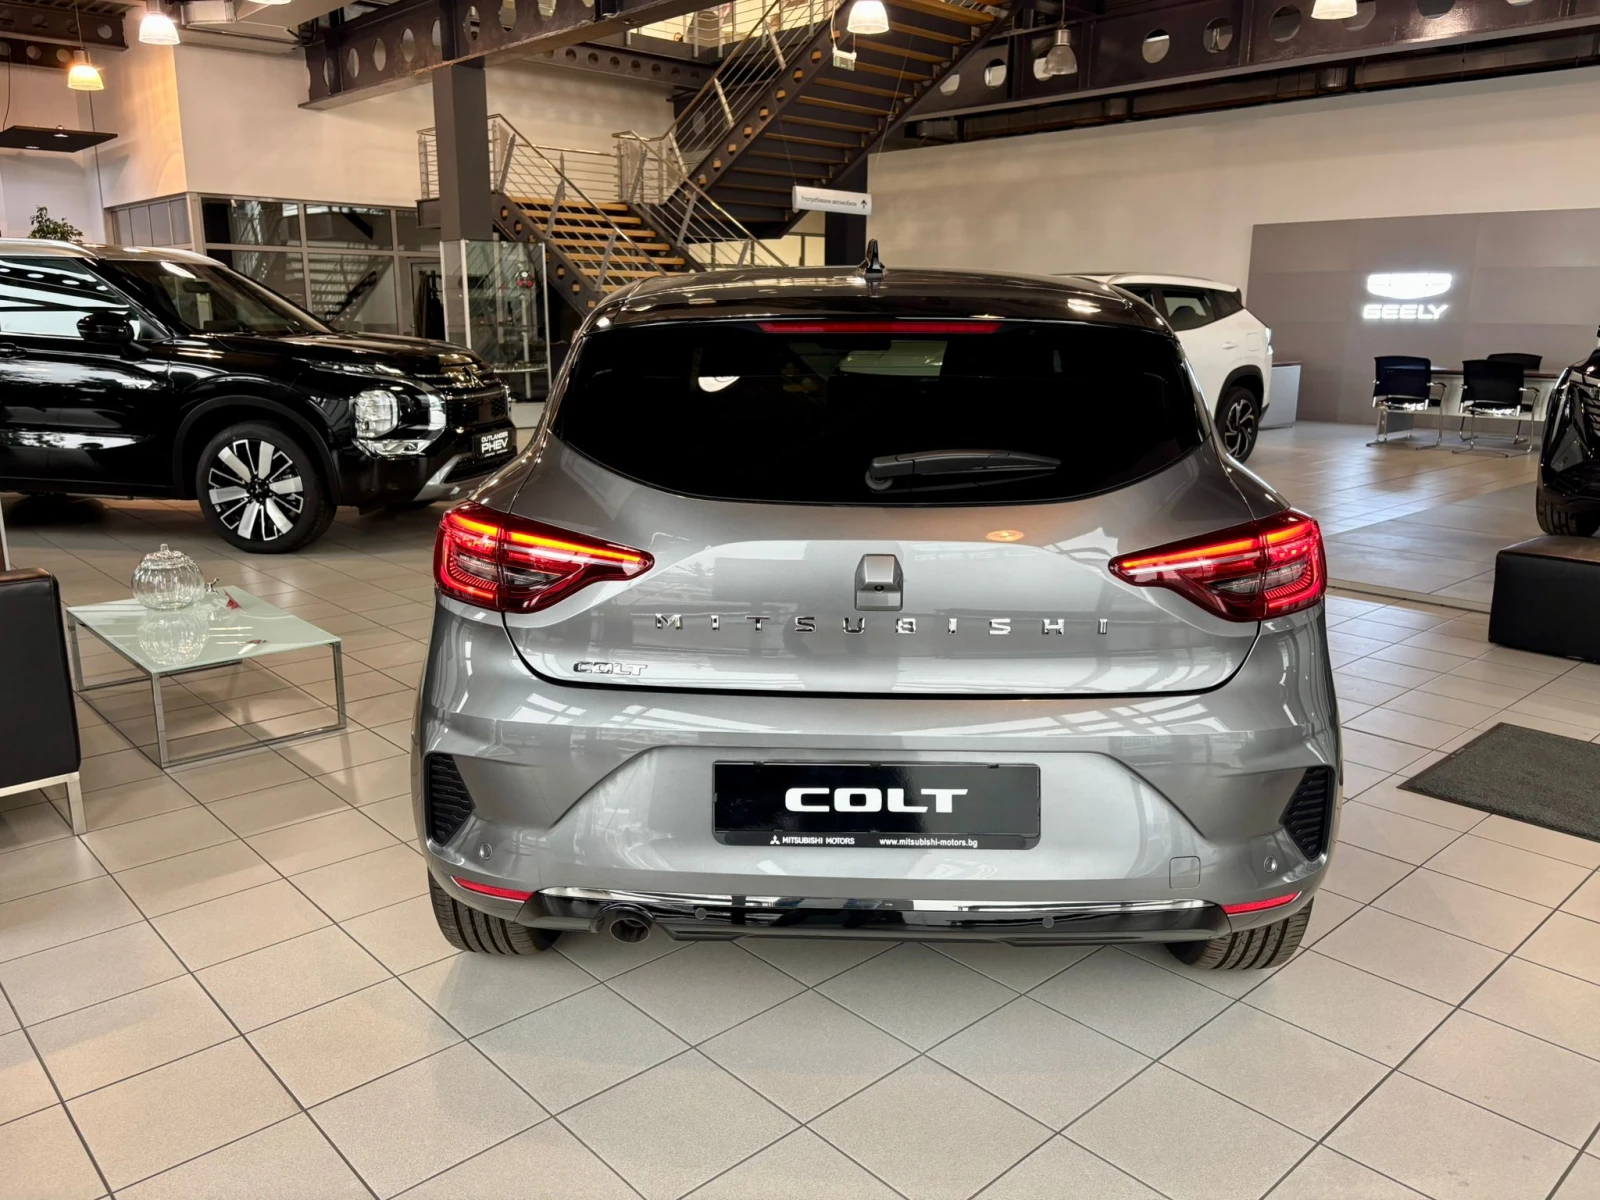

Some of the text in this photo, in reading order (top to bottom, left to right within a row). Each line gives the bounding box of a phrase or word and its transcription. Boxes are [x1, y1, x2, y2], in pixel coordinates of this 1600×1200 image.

[1363, 303, 1449, 320] GEELY
[481, 431, 508, 443] OUTLANDER
[481, 438, 508, 453] PHEV
[655, 613, 1108, 635] MITSUBISHI
[573, 661, 648, 676] COLT
[785, 787, 969, 813] COLT
[782, 836, 855, 845] MITSUBISHI MOTORS
[879, 837, 978, 848] www.mitsubishi-motors.bg
